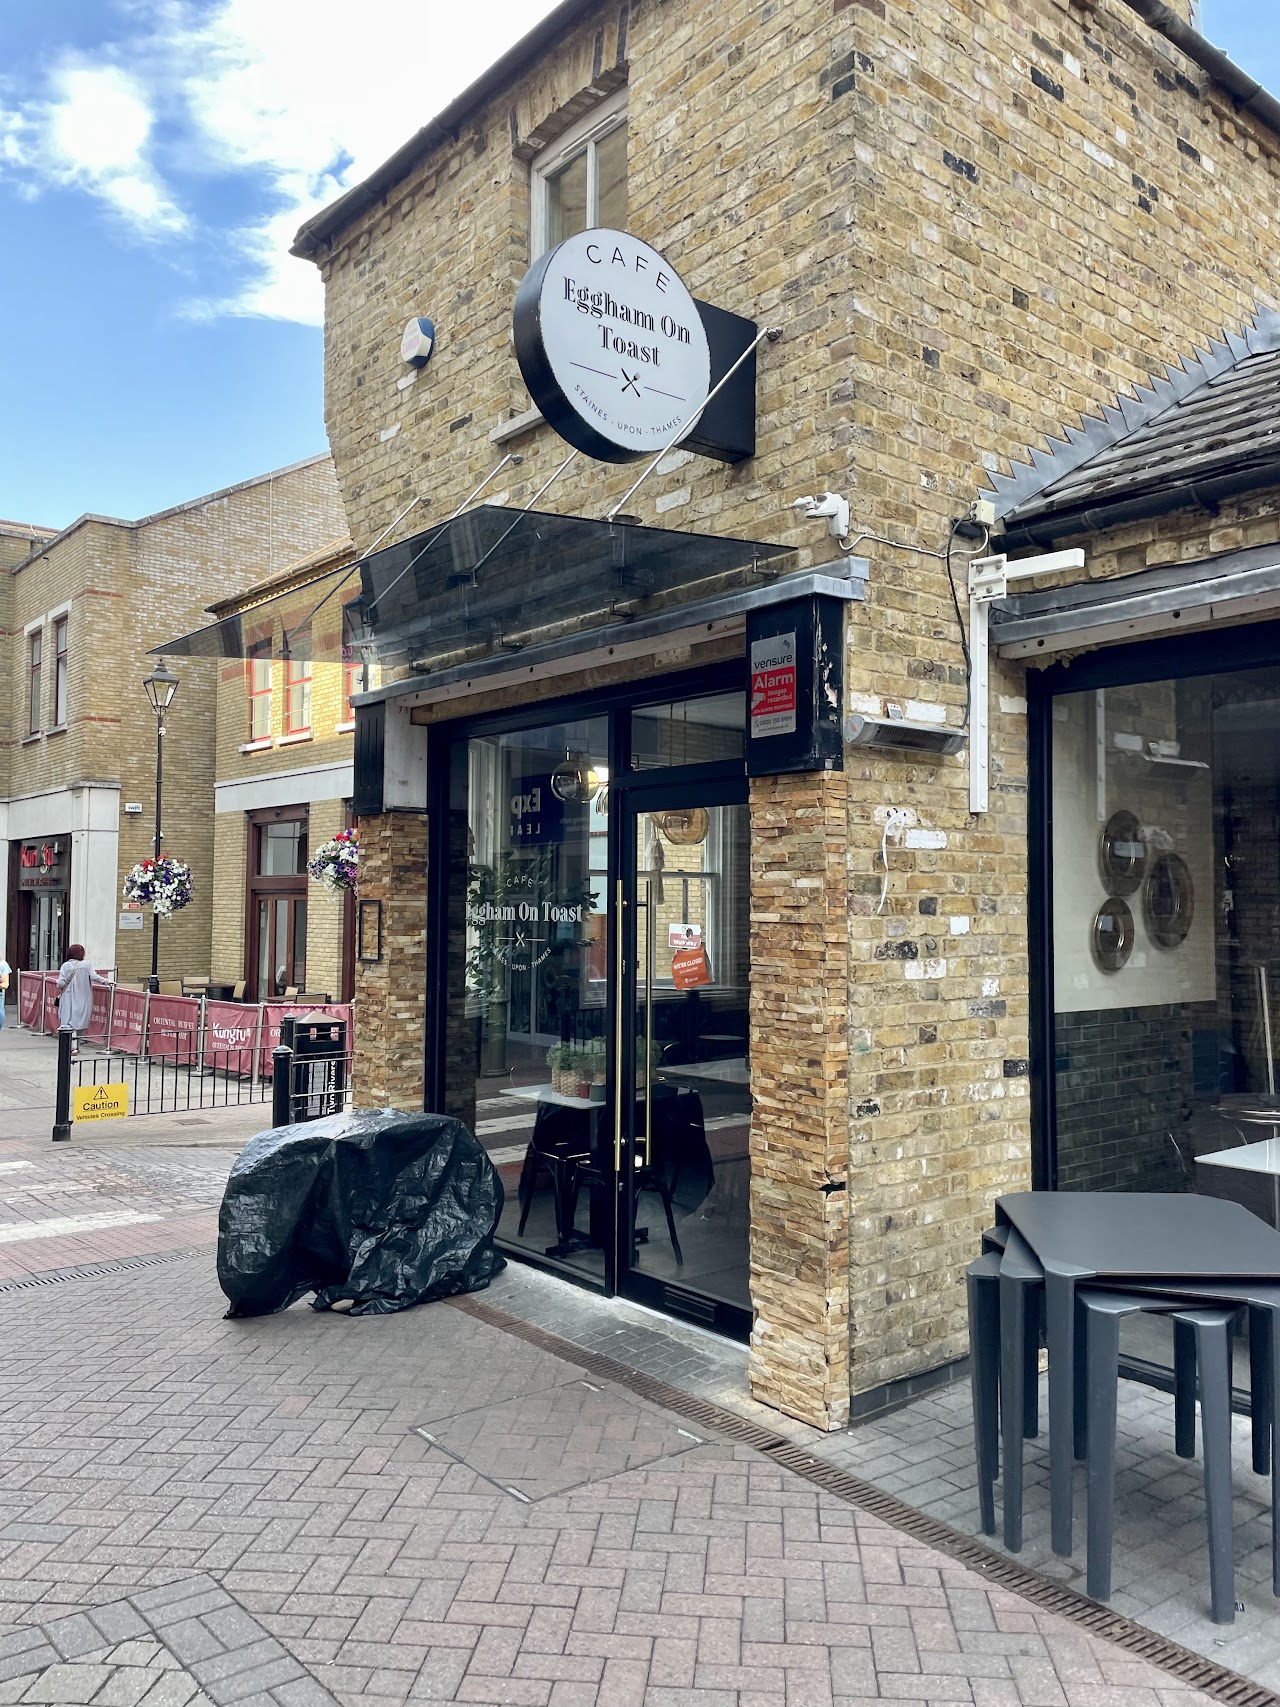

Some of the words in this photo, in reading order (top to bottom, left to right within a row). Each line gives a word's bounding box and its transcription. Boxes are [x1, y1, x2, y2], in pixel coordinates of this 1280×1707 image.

[586, 244, 671, 293] CAFE
[563, 276, 656, 332] Eggham
[661, 315, 692, 345] On
[598, 324, 661, 367] Toast
[574, 384, 608, 421] STAINES
[617, 420, 643, 435] UPON
[651, 416, 682, 436] THAMES
[753, 654, 793, 670] verisure
[753, 673, 793, 690] Alarm
[767, 693, 793, 703] recorded
[506, 875, 534, 888] CAFE
[518, 901, 540, 922] On
[541, 901, 583, 923] Toast
[511, 963, 527, 971] UPON
[531, 946, 552, 969] THAMES
[212, 1022, 246, 1045] Kungfu
[327, 1060, 336, 1092] Rivers
[82, 1101, 119, 1111] Caution
